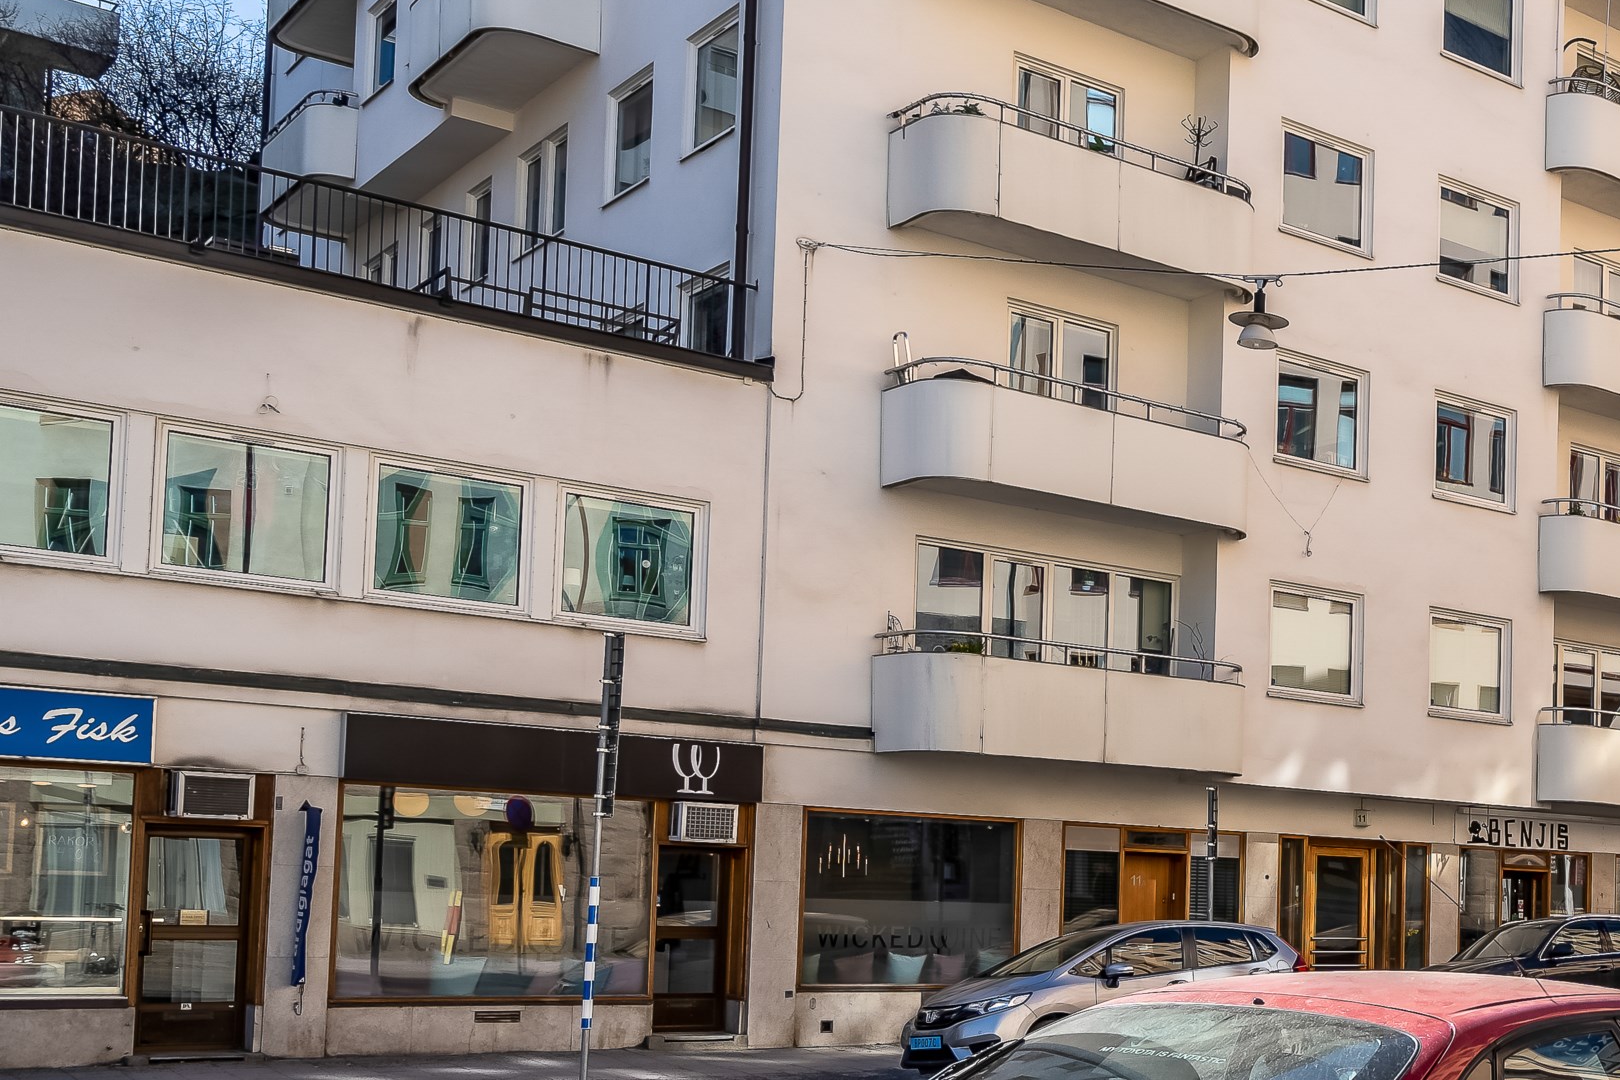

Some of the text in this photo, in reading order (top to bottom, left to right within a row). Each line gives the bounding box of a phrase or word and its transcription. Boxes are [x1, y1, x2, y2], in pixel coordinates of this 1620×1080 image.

[42, 707, 139, 744] Fisk
[1357, 814, 1366, 823] 11
[1488, 819, 1569, 850] BENJIS
[817, 924, 924, 949] WICKED
[1117, 1047, 1156, 1056] TOYOTA
[1167, 1051, 1226, 1064] FANTASTIC
